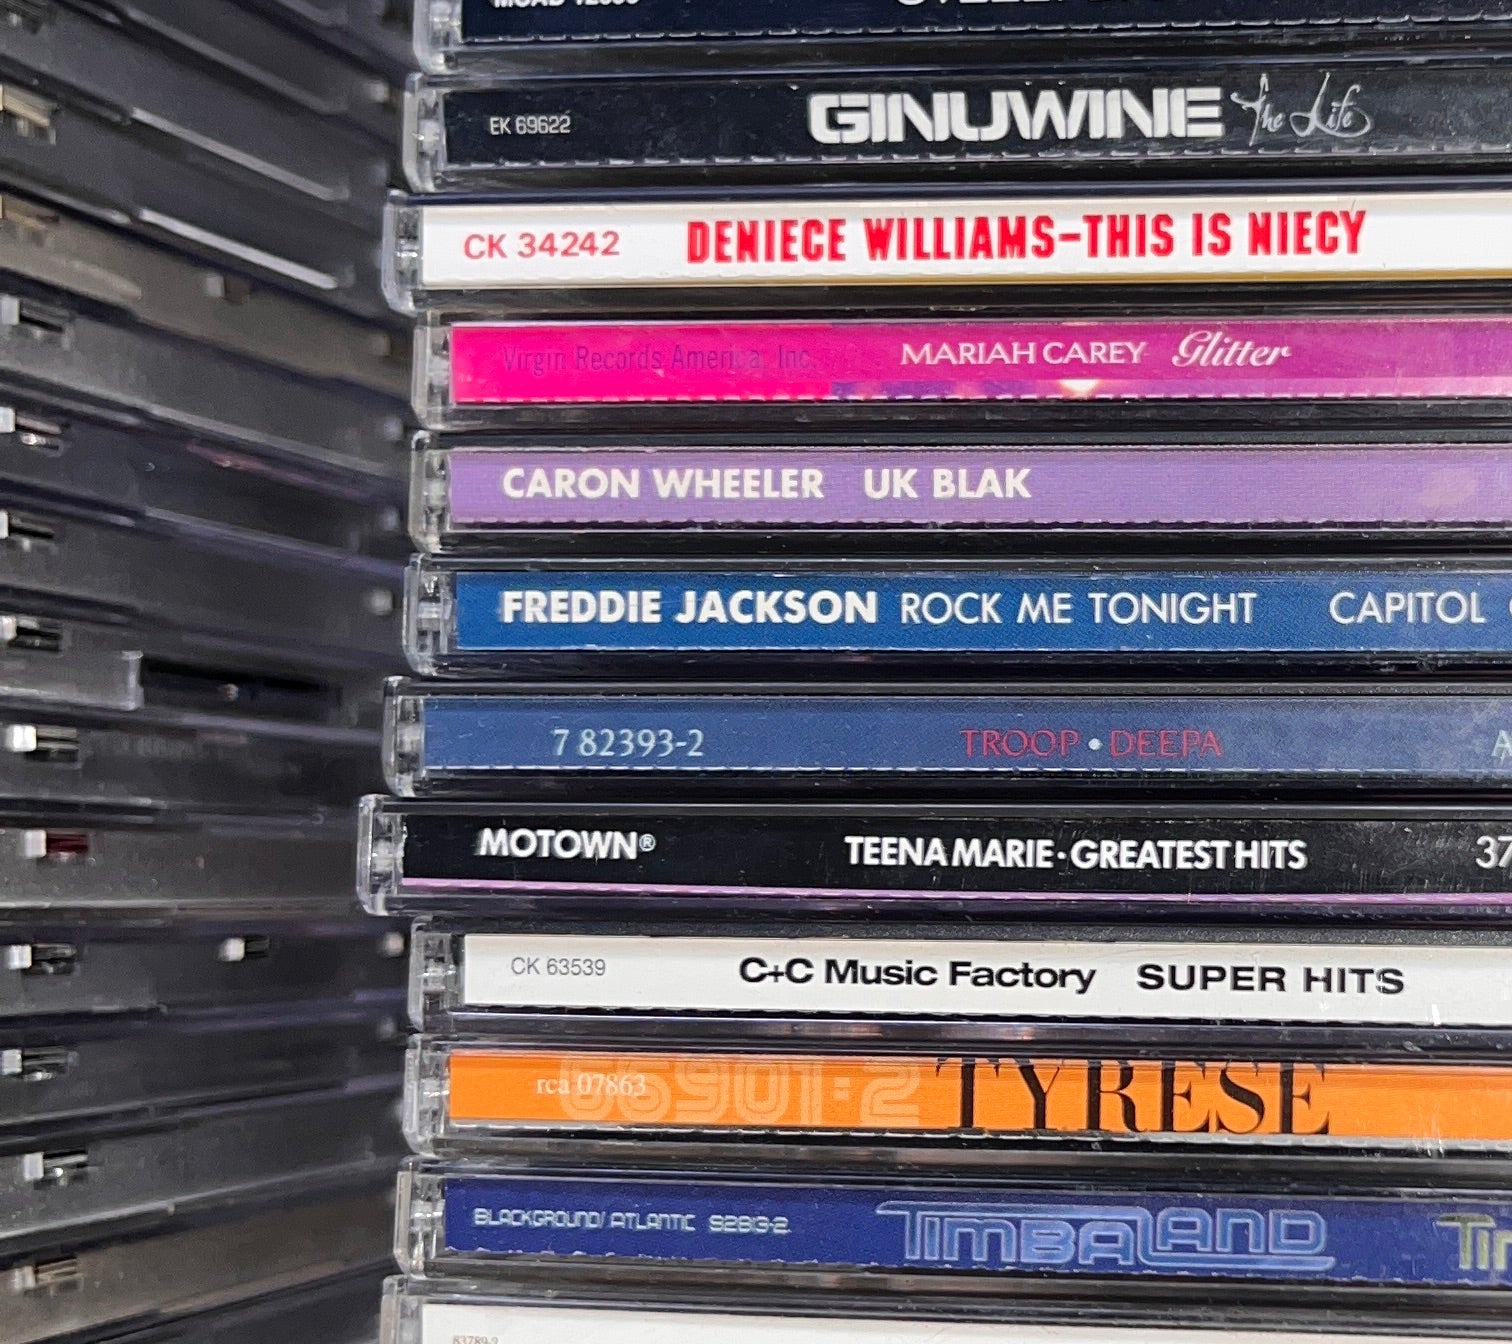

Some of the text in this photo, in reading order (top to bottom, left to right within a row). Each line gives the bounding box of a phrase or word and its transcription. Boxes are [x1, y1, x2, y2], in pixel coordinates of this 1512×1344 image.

[490, 114, 571, 136] EK 69622
[807, 87, 1222, 143] GINUWINE
[464, 231, 620, 259] CK 34242
[686, 210, 1367, 263] DENIECE IS NIECY
[503, 344, 663, 375] Virgin Records
[901, 331, 1291, 368] MARIAH CAREY Glitter
[504, 467, 1031, 500] CARON WHEELER UK BLAK
[503, 590, 1256, 625] FREDDIE JACKSON ROCK ME TONIGHT
[1329, 592, 1484, 625] CAPITOL
[578, 728, 704, 758] 82393-2
[960, 729, 1222, 757] TROOP DEEPA
[510, 955, 606, 977] CK 63539
[739, 957, 1405, 994] C+C Music Factory SUPER HITS
[536, 1073, 646, 1097] rca 07863
[935, 1058, 1332, 1135] TYRESE
[611, 1212, 696, 1231] ATLANTIC
